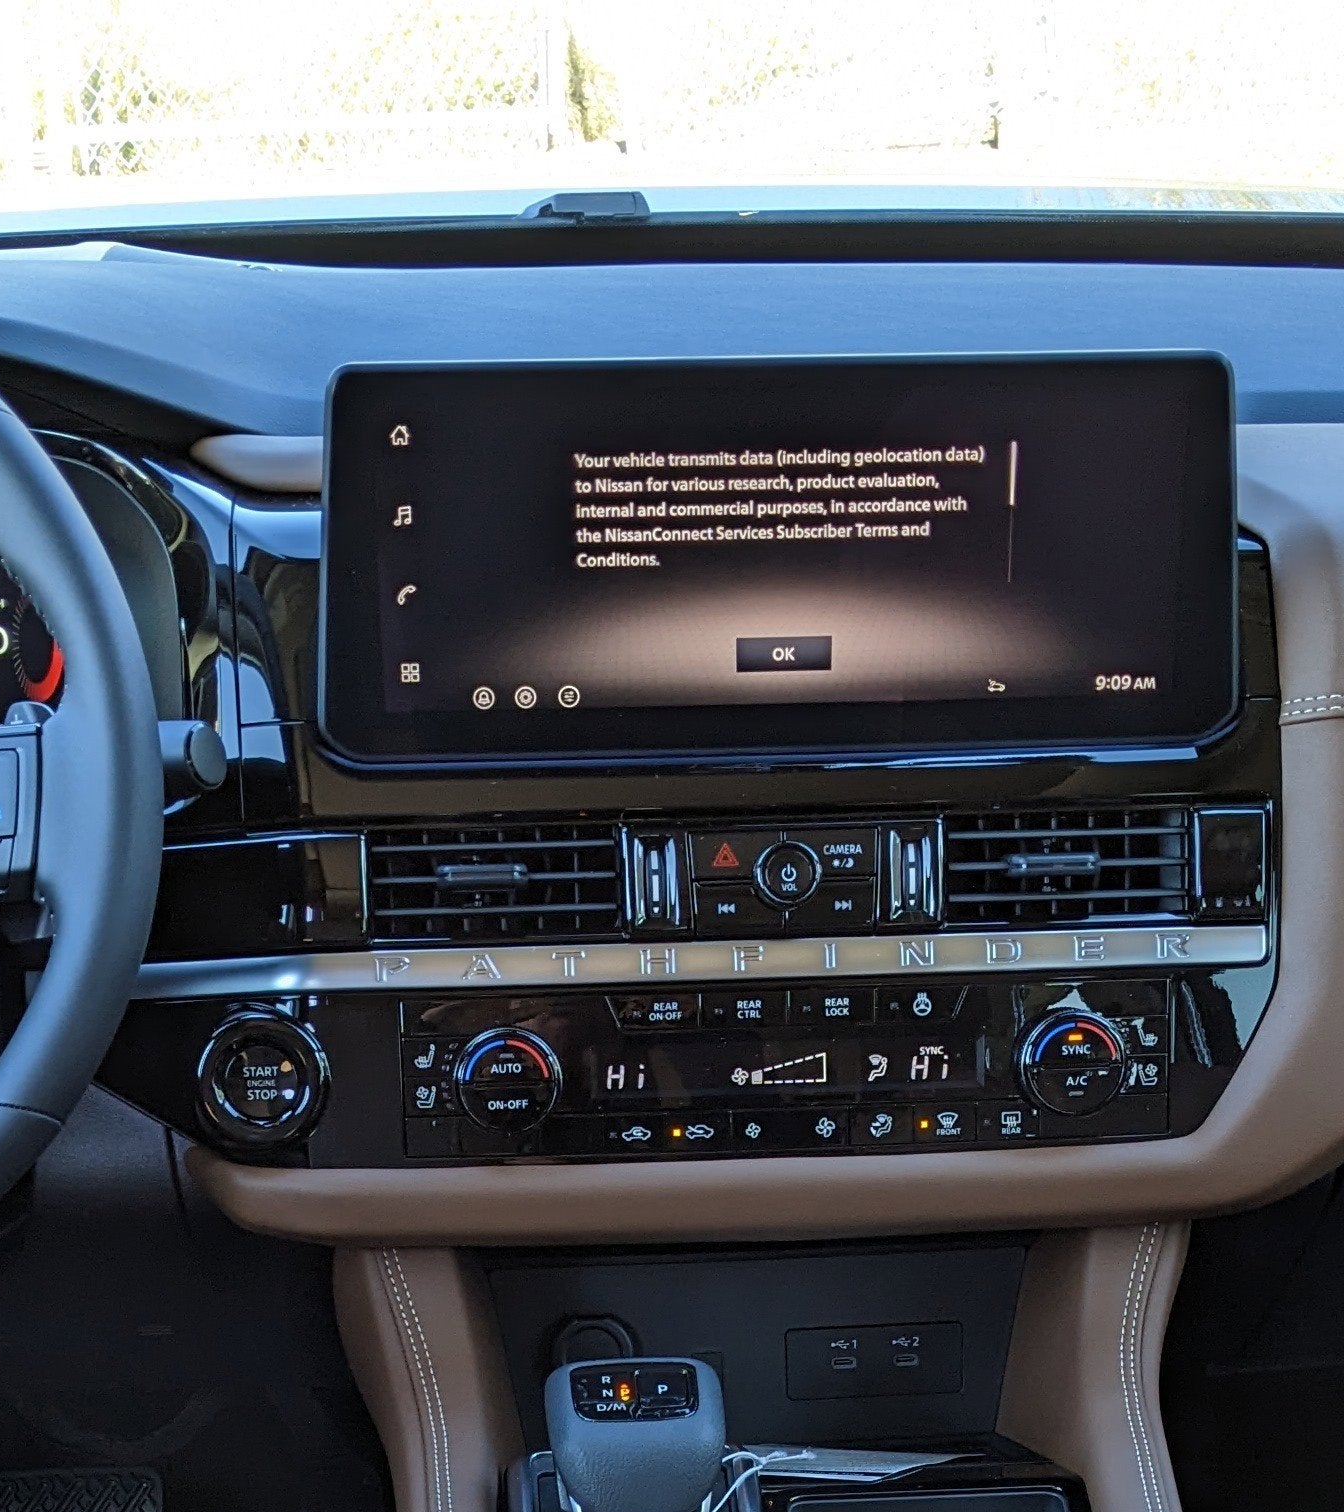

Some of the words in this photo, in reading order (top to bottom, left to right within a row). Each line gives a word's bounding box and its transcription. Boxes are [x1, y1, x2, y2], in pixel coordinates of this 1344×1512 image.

[574, 453, 608, 468] Your
[613, 452, 664, 467] vehicle
[668, 452, 736, 466] transmits
[740, 451, 773, 465] data
[777, 449, 850, 467] (including
[855, 448, 942, 466] geolocation
[946, 447, 984, 463] data)
[575, 481, 591, 493] to
[596, 479, 642, 492] Nissan
[647, 477, 669, 492] for
[672, 477, 724, 491] various
[729, 475, 794, 490] research,
[797, 474, 855, 492] product
[858, 473, 939, 488] evaluation,
[576, 503, 633, 518] internal
[637, 502, 665, 516] and
[670, 501, 753, 516] commercial
[757, 502, 827, 518] purposes,
[831, 500, 844, 513] in
[849, 498, 930, 512] accordance
[934, 496, 967, 511] with
[576, 528, 601, 543] the
[606, 528, 713, 541] NissanConnect
[716, 526, 773, 539] Services
[777, 524, 852, 538] Subscriber
[856, 523, 898, 536] Terms
[902, 522, 929, 536] and
[577, 553, 660, 568] Conditions.
[772, 648, 795, 662] OK
[1095, 675, 1131, 691] 9:09
[1133, 677, 1156, 690] AM
[823, 845, 862, 855] CAMERA
[781, 883, 797, 891] VOL
[374, 932, 1190, 982] PATHFINDER
[654, 1002, 678, 1011] REAR
[737, 1000, 761, 1009] REAR
[825, 998, 849, 1006] REAR
[738, 1010, 761, 1019] CTRL
[826, 1008, 849, 1016] LOCK
[920, 1046, 944, 1054] SYNC
[1062, 1045, 1090, 1055] SYNC
[243, 1067, 278, 1077] START
[491, 1063, 521, 1074] AUTO
[911, 1055, 948, 1080] Hi
[606, 1064, 645, 1089] Hi
[1066, 1076, 1087, 1086] A/C
[247, 1090, 277, 1100] STOP
[937, 1128, 961, 1136] FRONT
[912, 1337, 920, 1347] 2
[603, 1389, 613, 1397] N
[658, 1385, 667, 1394] P
